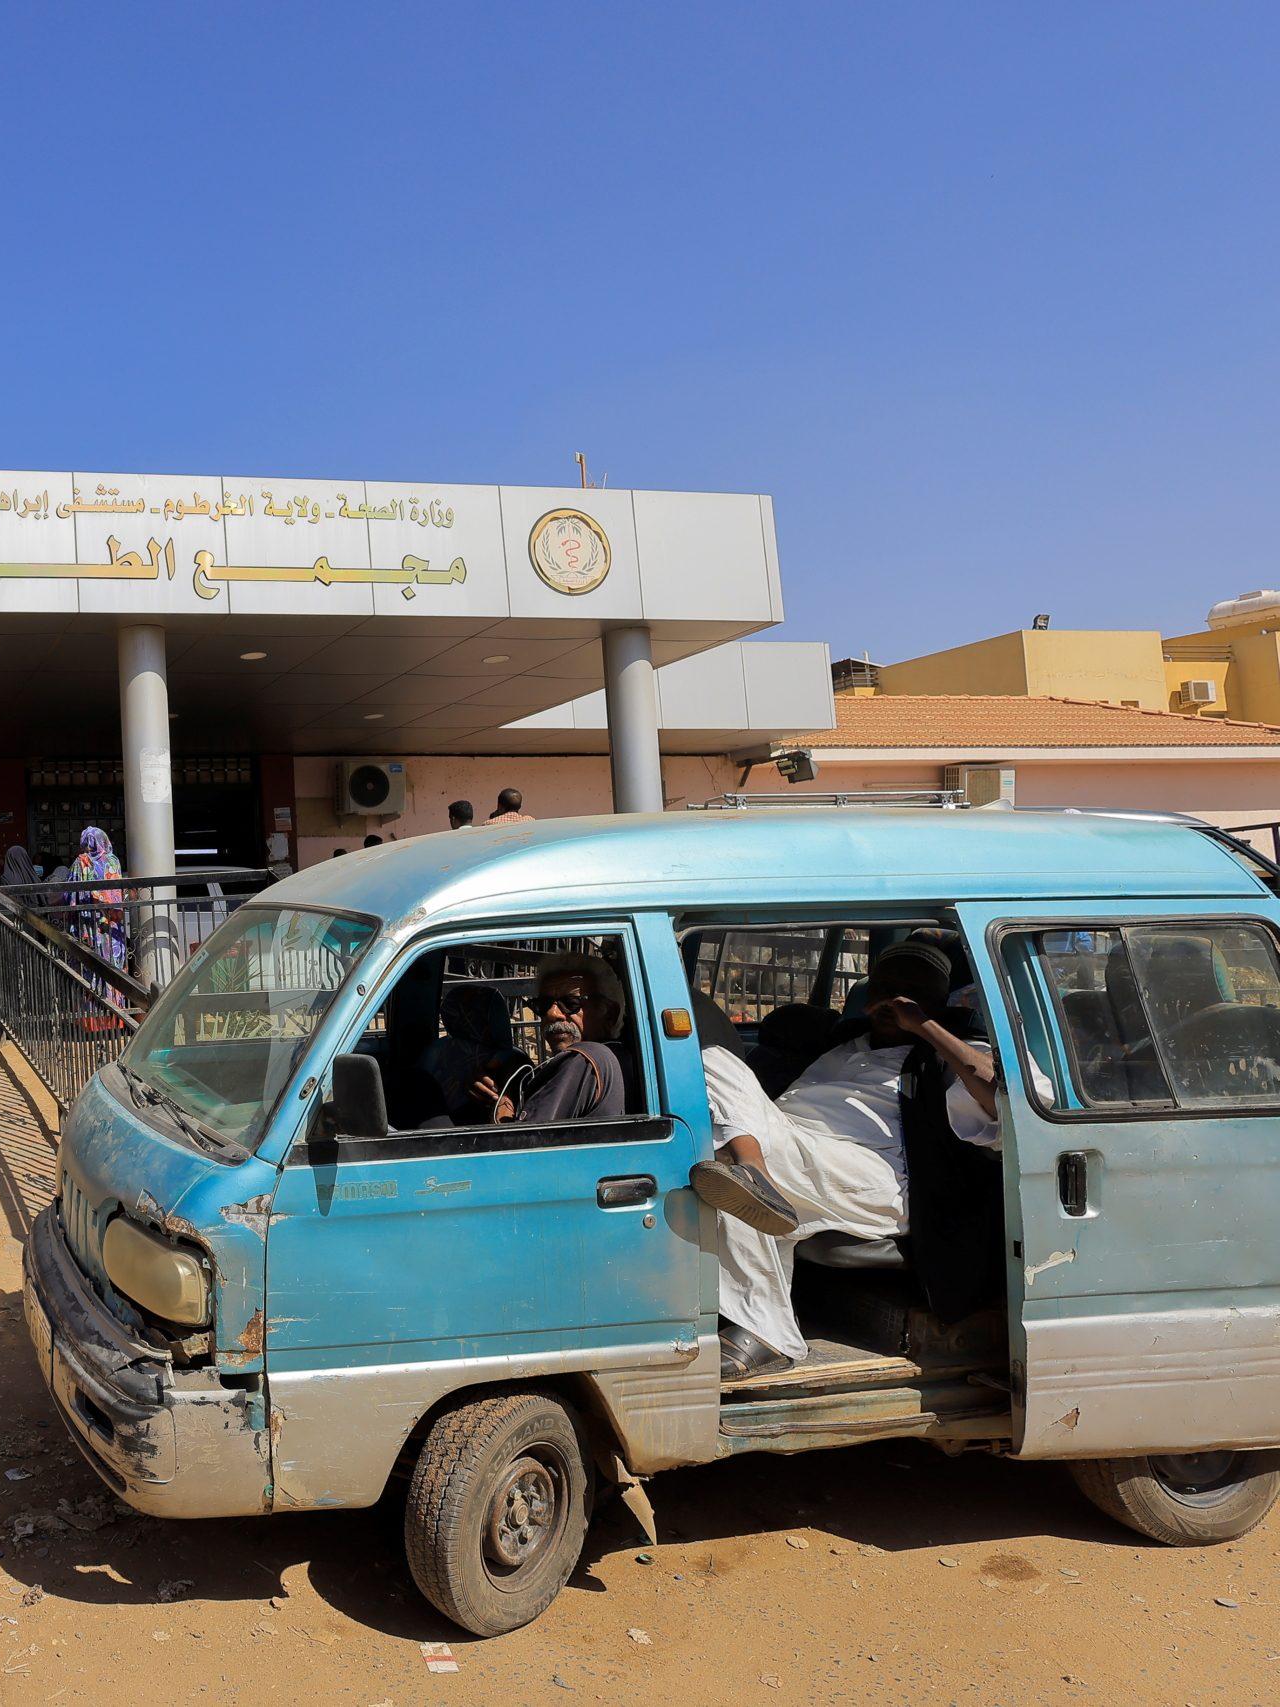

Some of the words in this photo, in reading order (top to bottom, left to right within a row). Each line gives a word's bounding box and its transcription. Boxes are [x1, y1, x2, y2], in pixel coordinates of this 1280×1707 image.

[55, 483, 145, 519] مستشفى
[163, 491, 254, 521] الخرطوم
[261, 491, 321, 525] ولاية
[336, 493, 405, 520] الصحة
[409, 496, 456, 529] وزارة
[192, 549, 467, 601] مجمع
